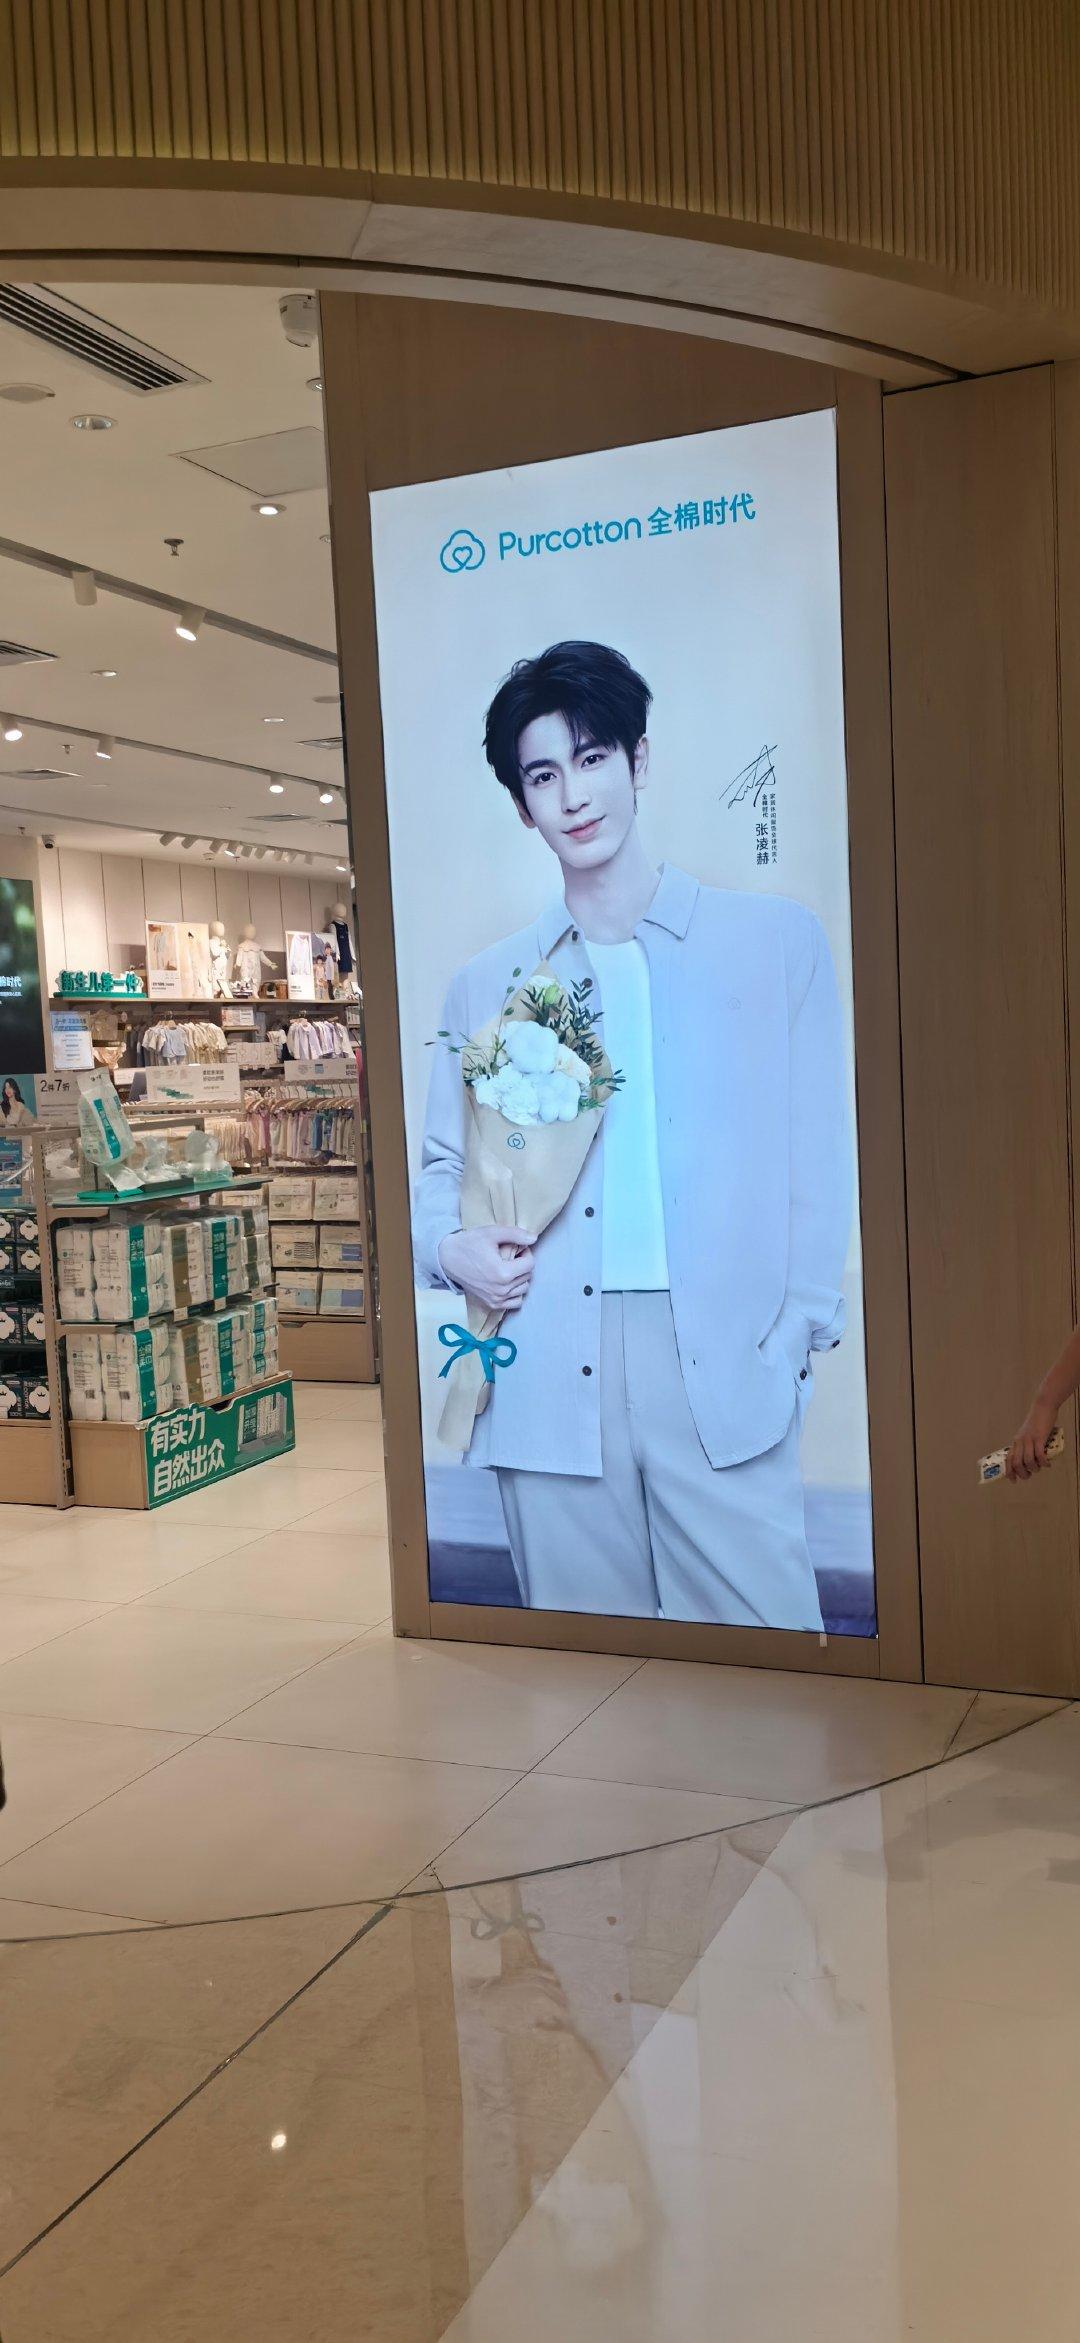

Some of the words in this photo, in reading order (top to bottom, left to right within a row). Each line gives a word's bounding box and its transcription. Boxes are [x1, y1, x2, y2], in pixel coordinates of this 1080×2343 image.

[648, 492, 756, 536] 全棉时代
[499, 517, 642, 560] Purcotton
[755, 823, 769, 865] 张凌赫
[151, 1408, 206, 1457] 有实力
[154, 1438, 225, 1497] 自然出众
